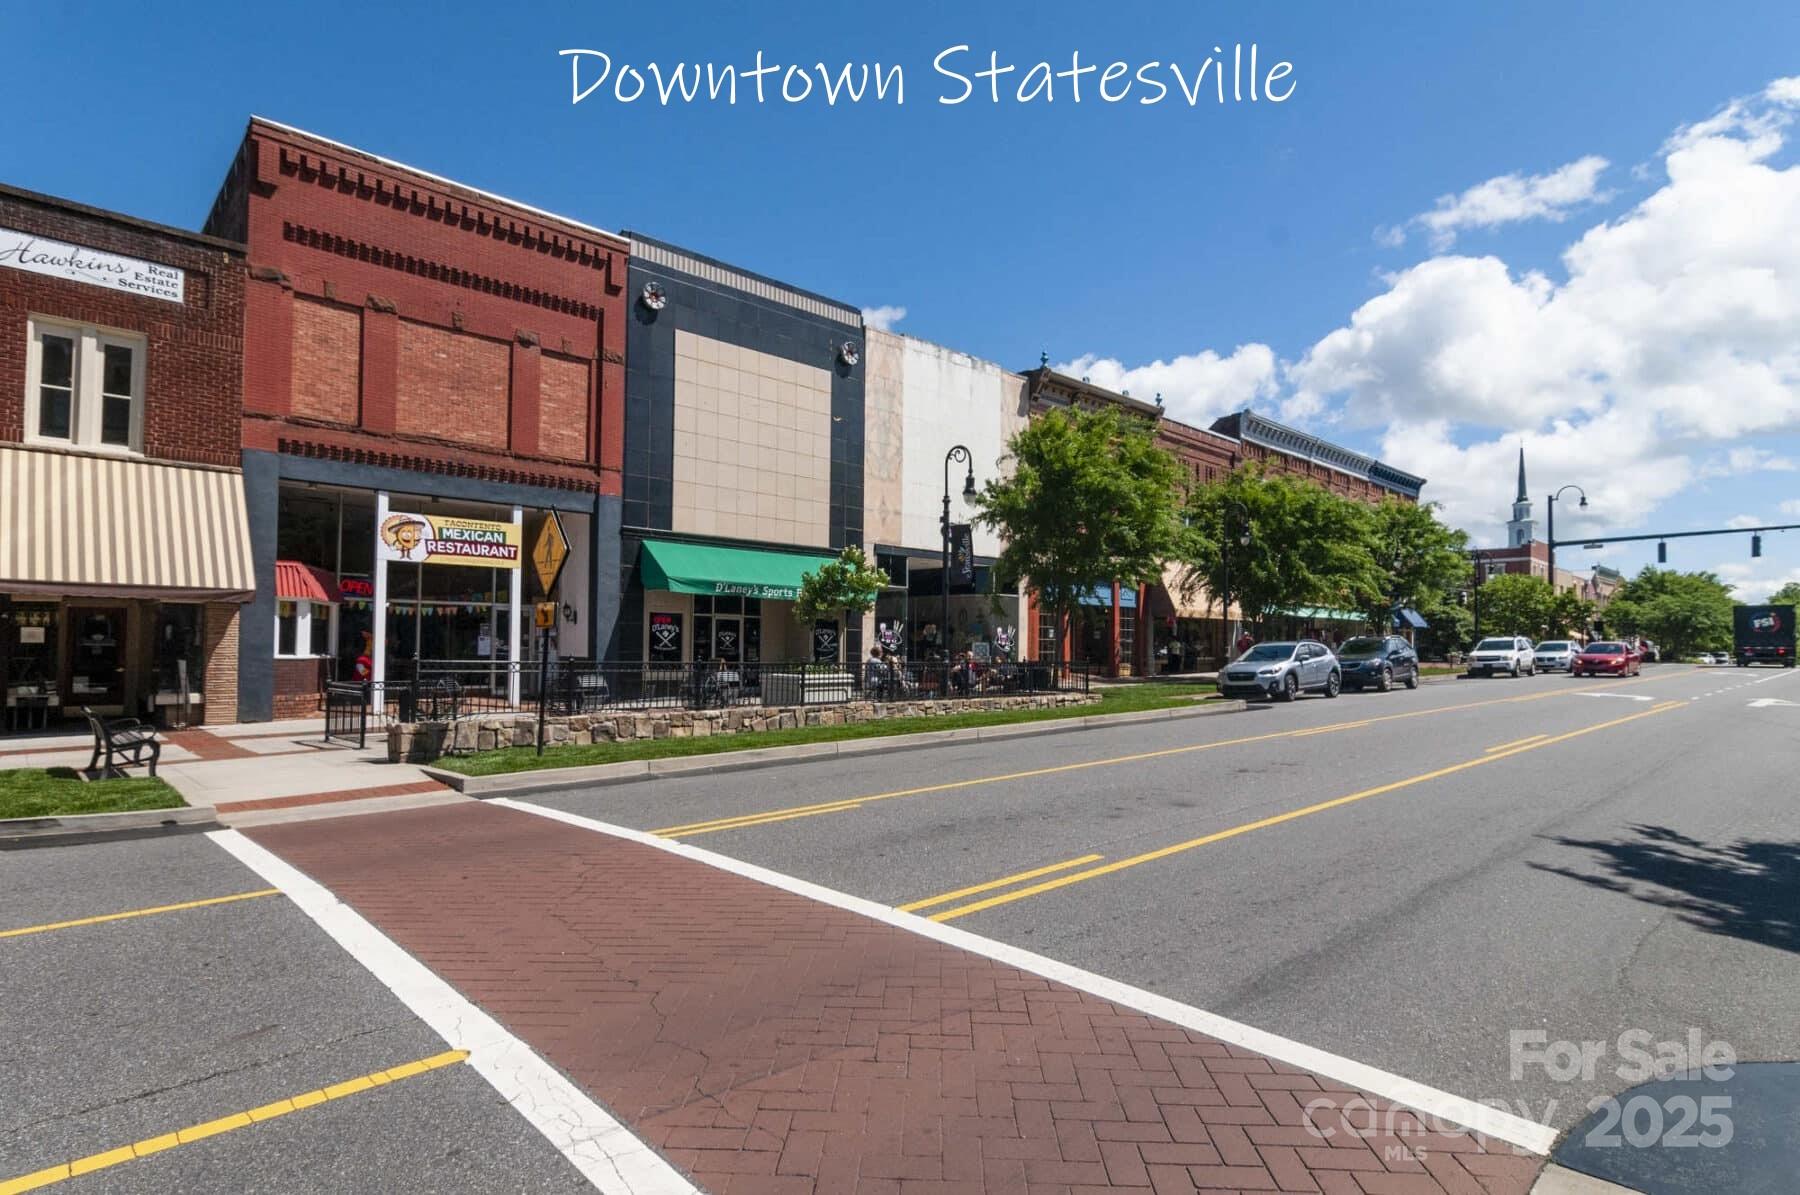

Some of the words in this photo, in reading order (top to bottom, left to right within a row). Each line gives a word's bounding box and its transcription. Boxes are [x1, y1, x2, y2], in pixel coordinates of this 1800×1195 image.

[0, 239, 129, 275] Hawkins
[134, 271, 179, 289] Estate
[148, 265, 179, 280] Real
[118, 277, 179, 298] Services
[442, 527, 503, 544] MEXICAN
[426, 540, 517, 559] RESTAURANT
[340, 579, 374, 596] OPEN
[715, 582, 759, 596] D'Laney's
[762, 586, 793, 598] Sports
[1752, 616, 1775, 628] FSI
